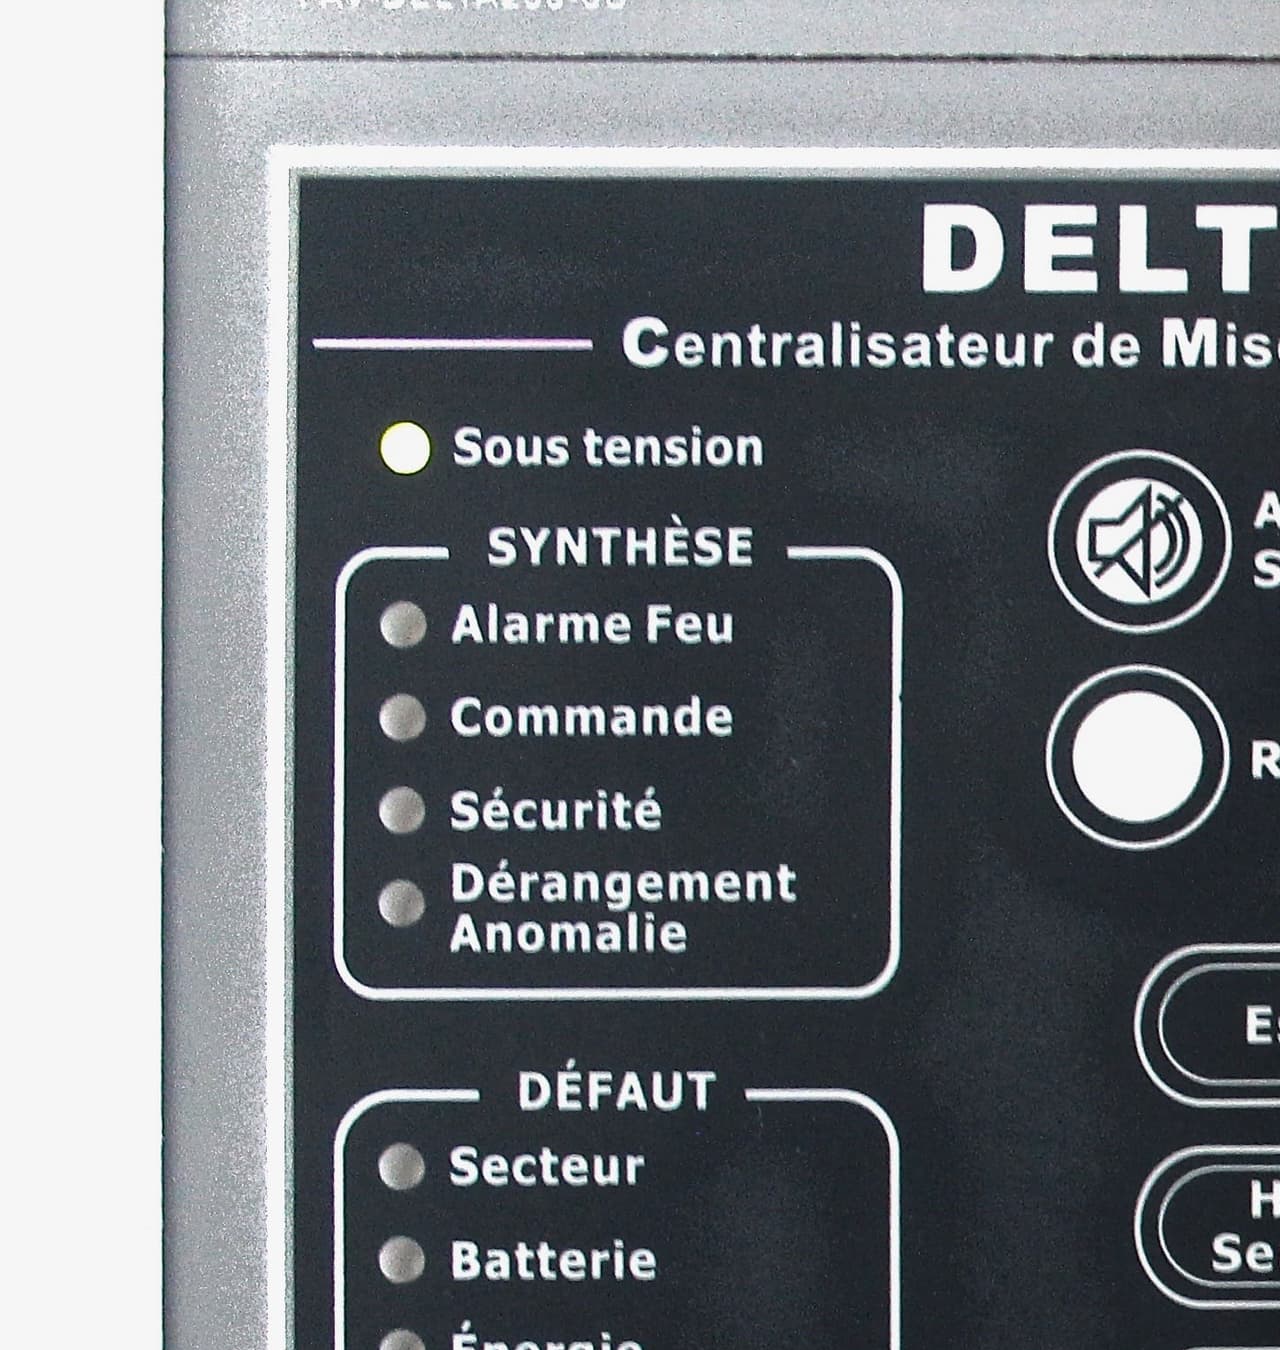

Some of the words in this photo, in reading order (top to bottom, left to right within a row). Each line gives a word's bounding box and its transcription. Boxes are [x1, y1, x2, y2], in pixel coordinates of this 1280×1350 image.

[623, 317, 1053, 367] Centralisateur
[1073, 322, 1140, 367] de
[454, 427, 569, 465] Sous
[584, 426, 762, 466] tension
[489, 514, 752, 566] SYNTHÈSE
[452, 603, 630, 643] Alarme
[648, 605, 732, 643] Feu
[452, 696, 732, 736] Commande
[451, 787, 661, 830] Sécurité
[453, 860, 796, 910] Dérangement
[450, 912, 686, 952] Anomalie
[520, 1059, 715, 1110] DÉFAUT
[451, 1146, 644, 1185] Secteur
[453, 1240, 655, 1279] Batterie
